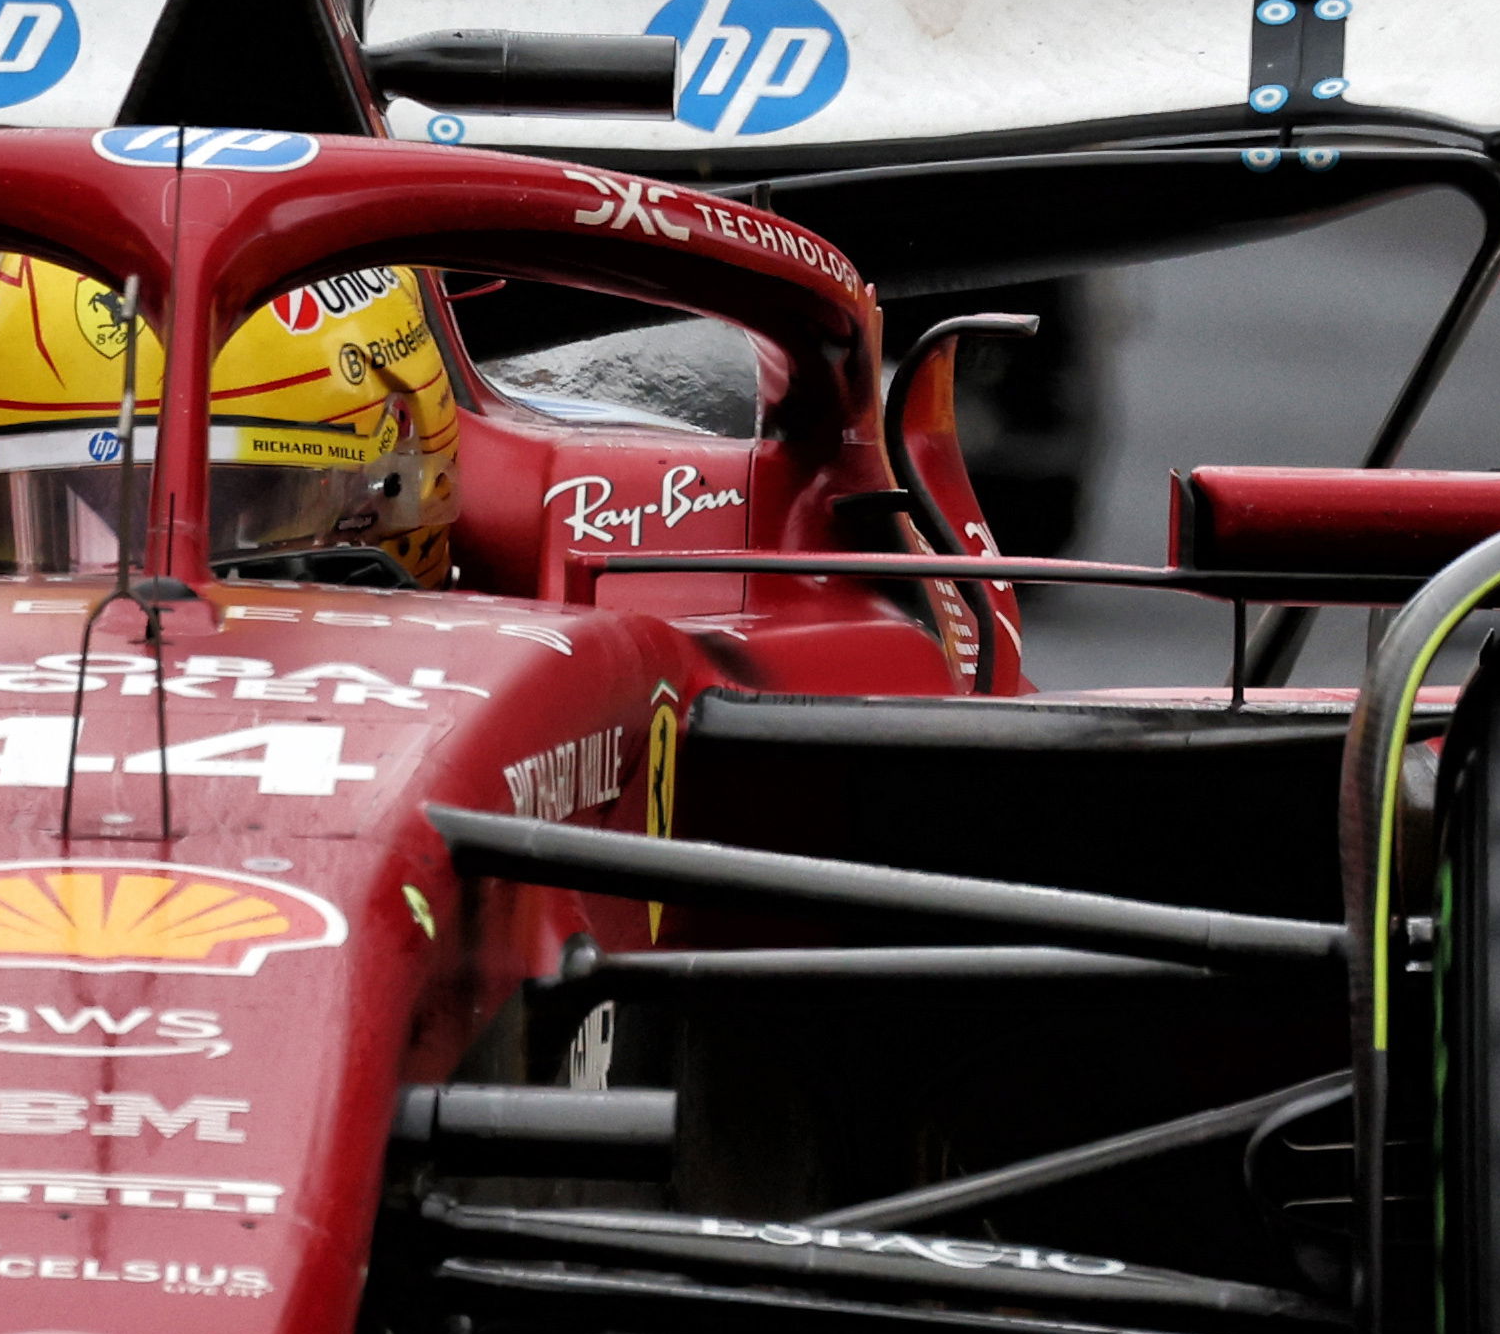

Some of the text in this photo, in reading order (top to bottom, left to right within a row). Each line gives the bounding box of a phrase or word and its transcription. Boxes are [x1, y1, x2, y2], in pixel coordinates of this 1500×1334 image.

[563, 169, 859, 299] DXC TECHNOLOGY
[92, 431, 118, 461] hp
[253, 438, 366, 462] RICHARD MILLE
[543, 465, 746, 547] Ray-Ban
